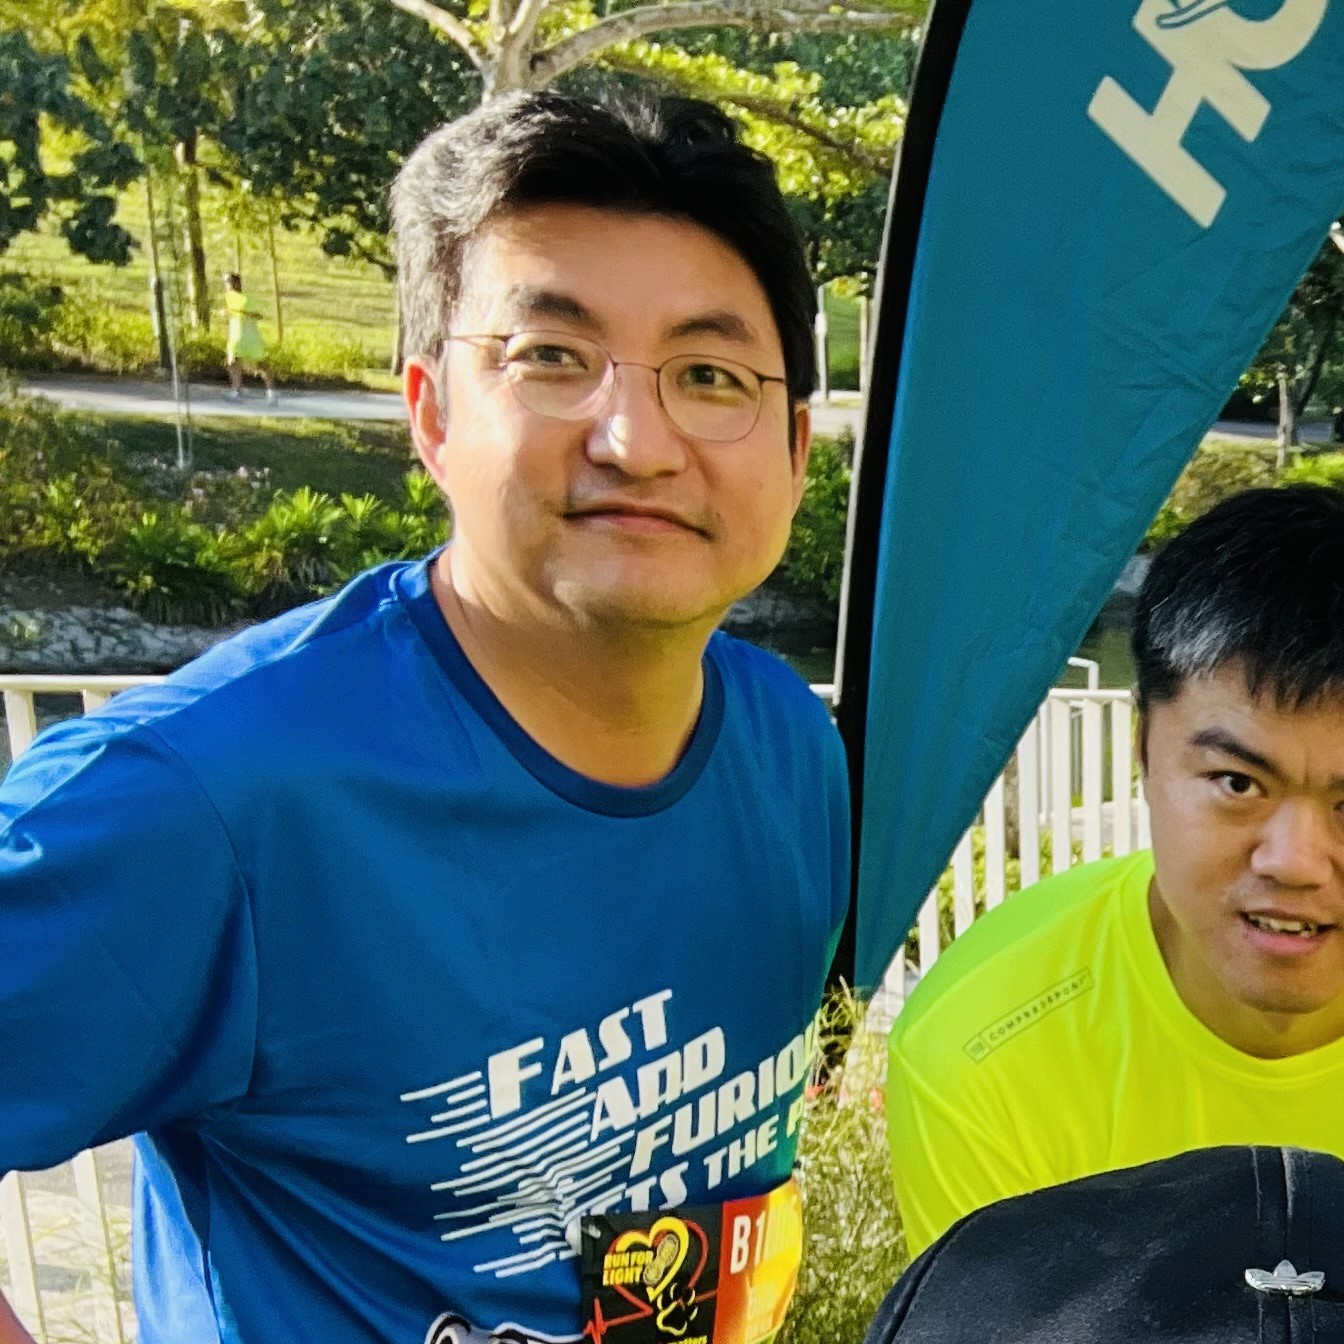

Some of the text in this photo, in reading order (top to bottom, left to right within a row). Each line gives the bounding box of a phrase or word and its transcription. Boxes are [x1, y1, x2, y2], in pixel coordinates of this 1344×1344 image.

[488, 988, 672, 1120] FAST
[590, 1027, 726, 1142] AND
[703, 1114, 780, 1190] THE
[602, 1266, 643, 1287] LIGHT
[604, 1253, 629, 1269] RUN
